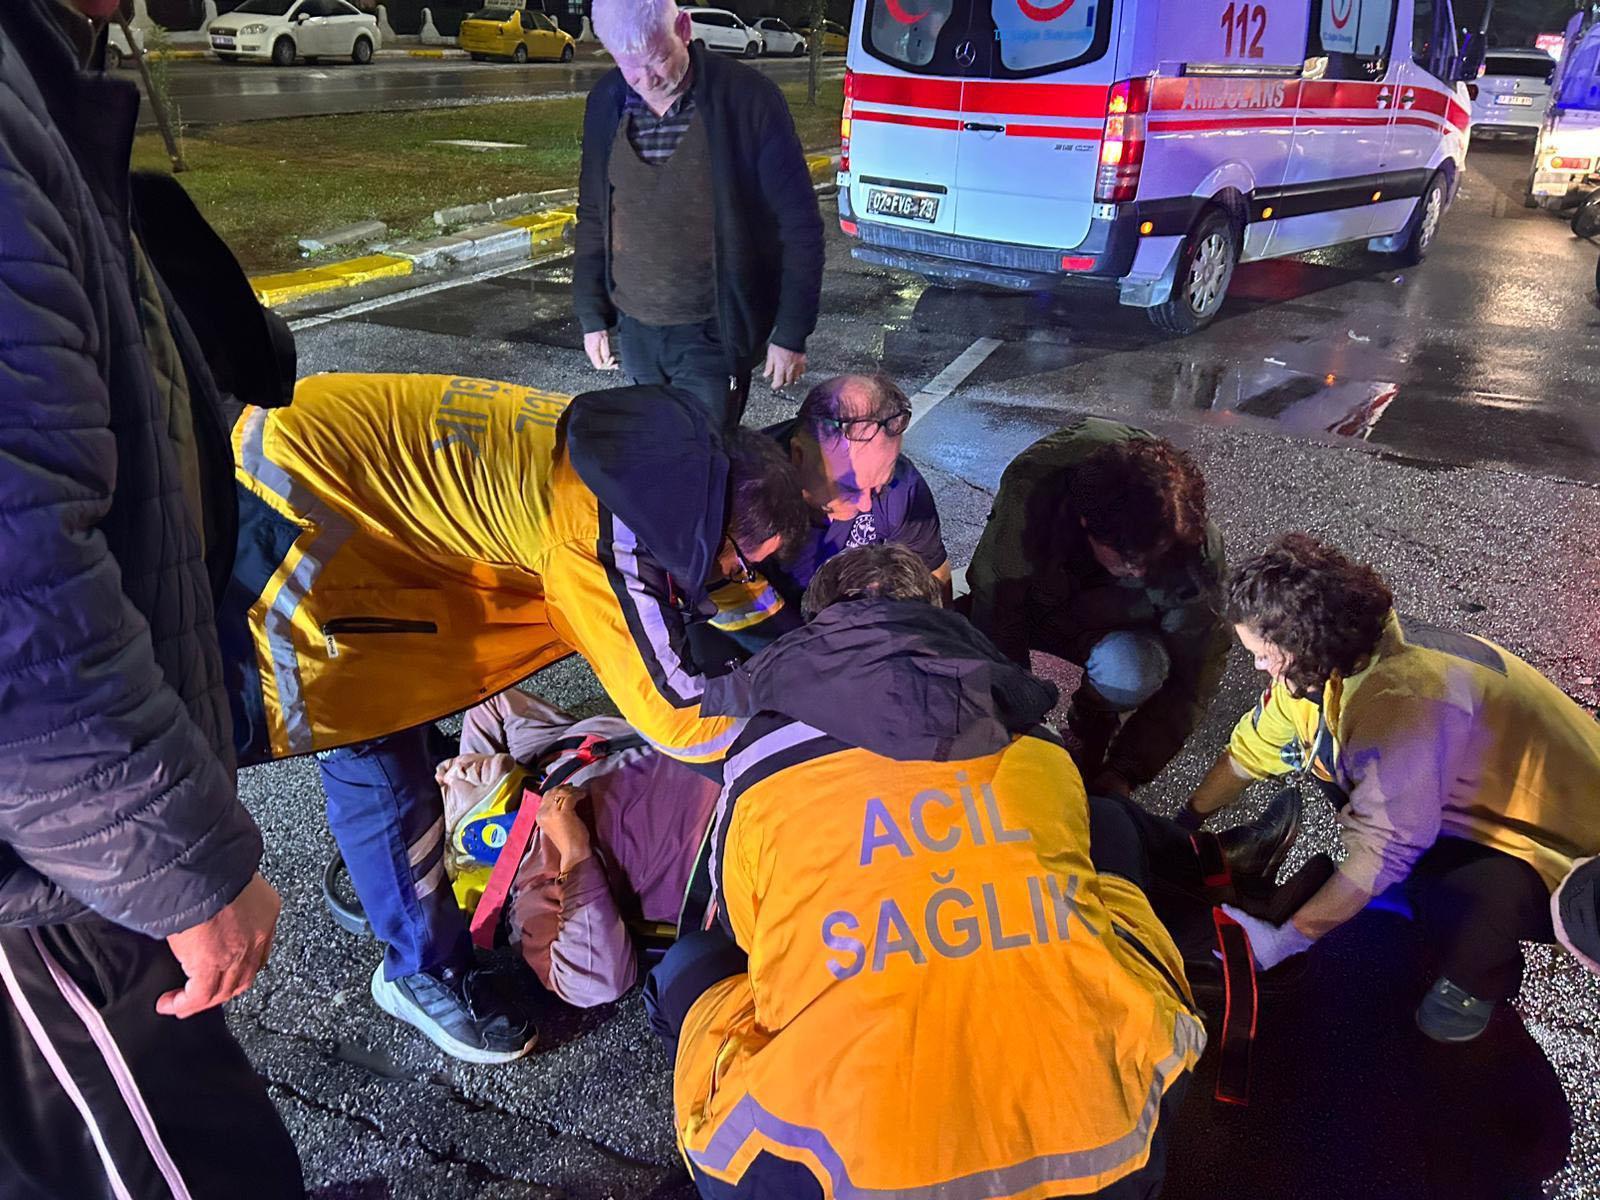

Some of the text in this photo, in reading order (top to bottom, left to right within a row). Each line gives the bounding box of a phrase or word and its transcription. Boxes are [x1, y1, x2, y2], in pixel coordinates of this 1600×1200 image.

[1220, 2, 1266, 58] 112
[859, 770, 1034, 867] ACİL
[821, 867, 1100, 982] SAĞLIK
